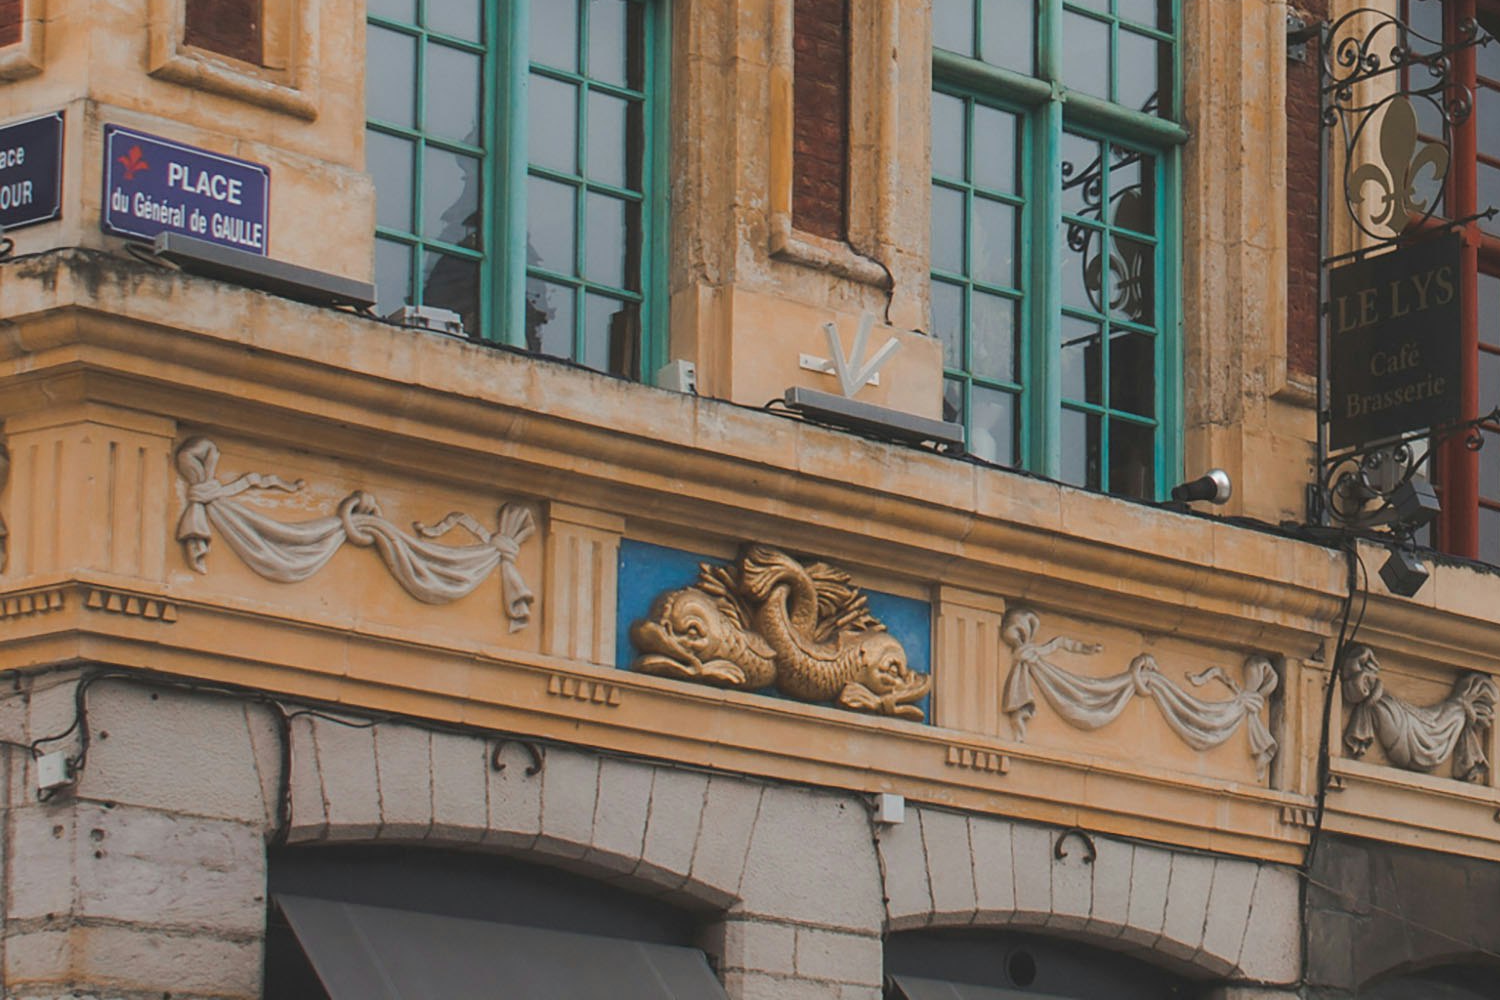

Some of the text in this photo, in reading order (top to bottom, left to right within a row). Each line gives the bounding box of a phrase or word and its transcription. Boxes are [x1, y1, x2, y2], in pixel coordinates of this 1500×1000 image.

[168, 162, 242, 205] PLACE
[112, 187, 262, 248] du Général de GAULLE
[1336, 265, 1455, 334] LE LYS
[1371, 341, 1420, 377] Café
[1345, 373, 1446, 419] Brasserie
